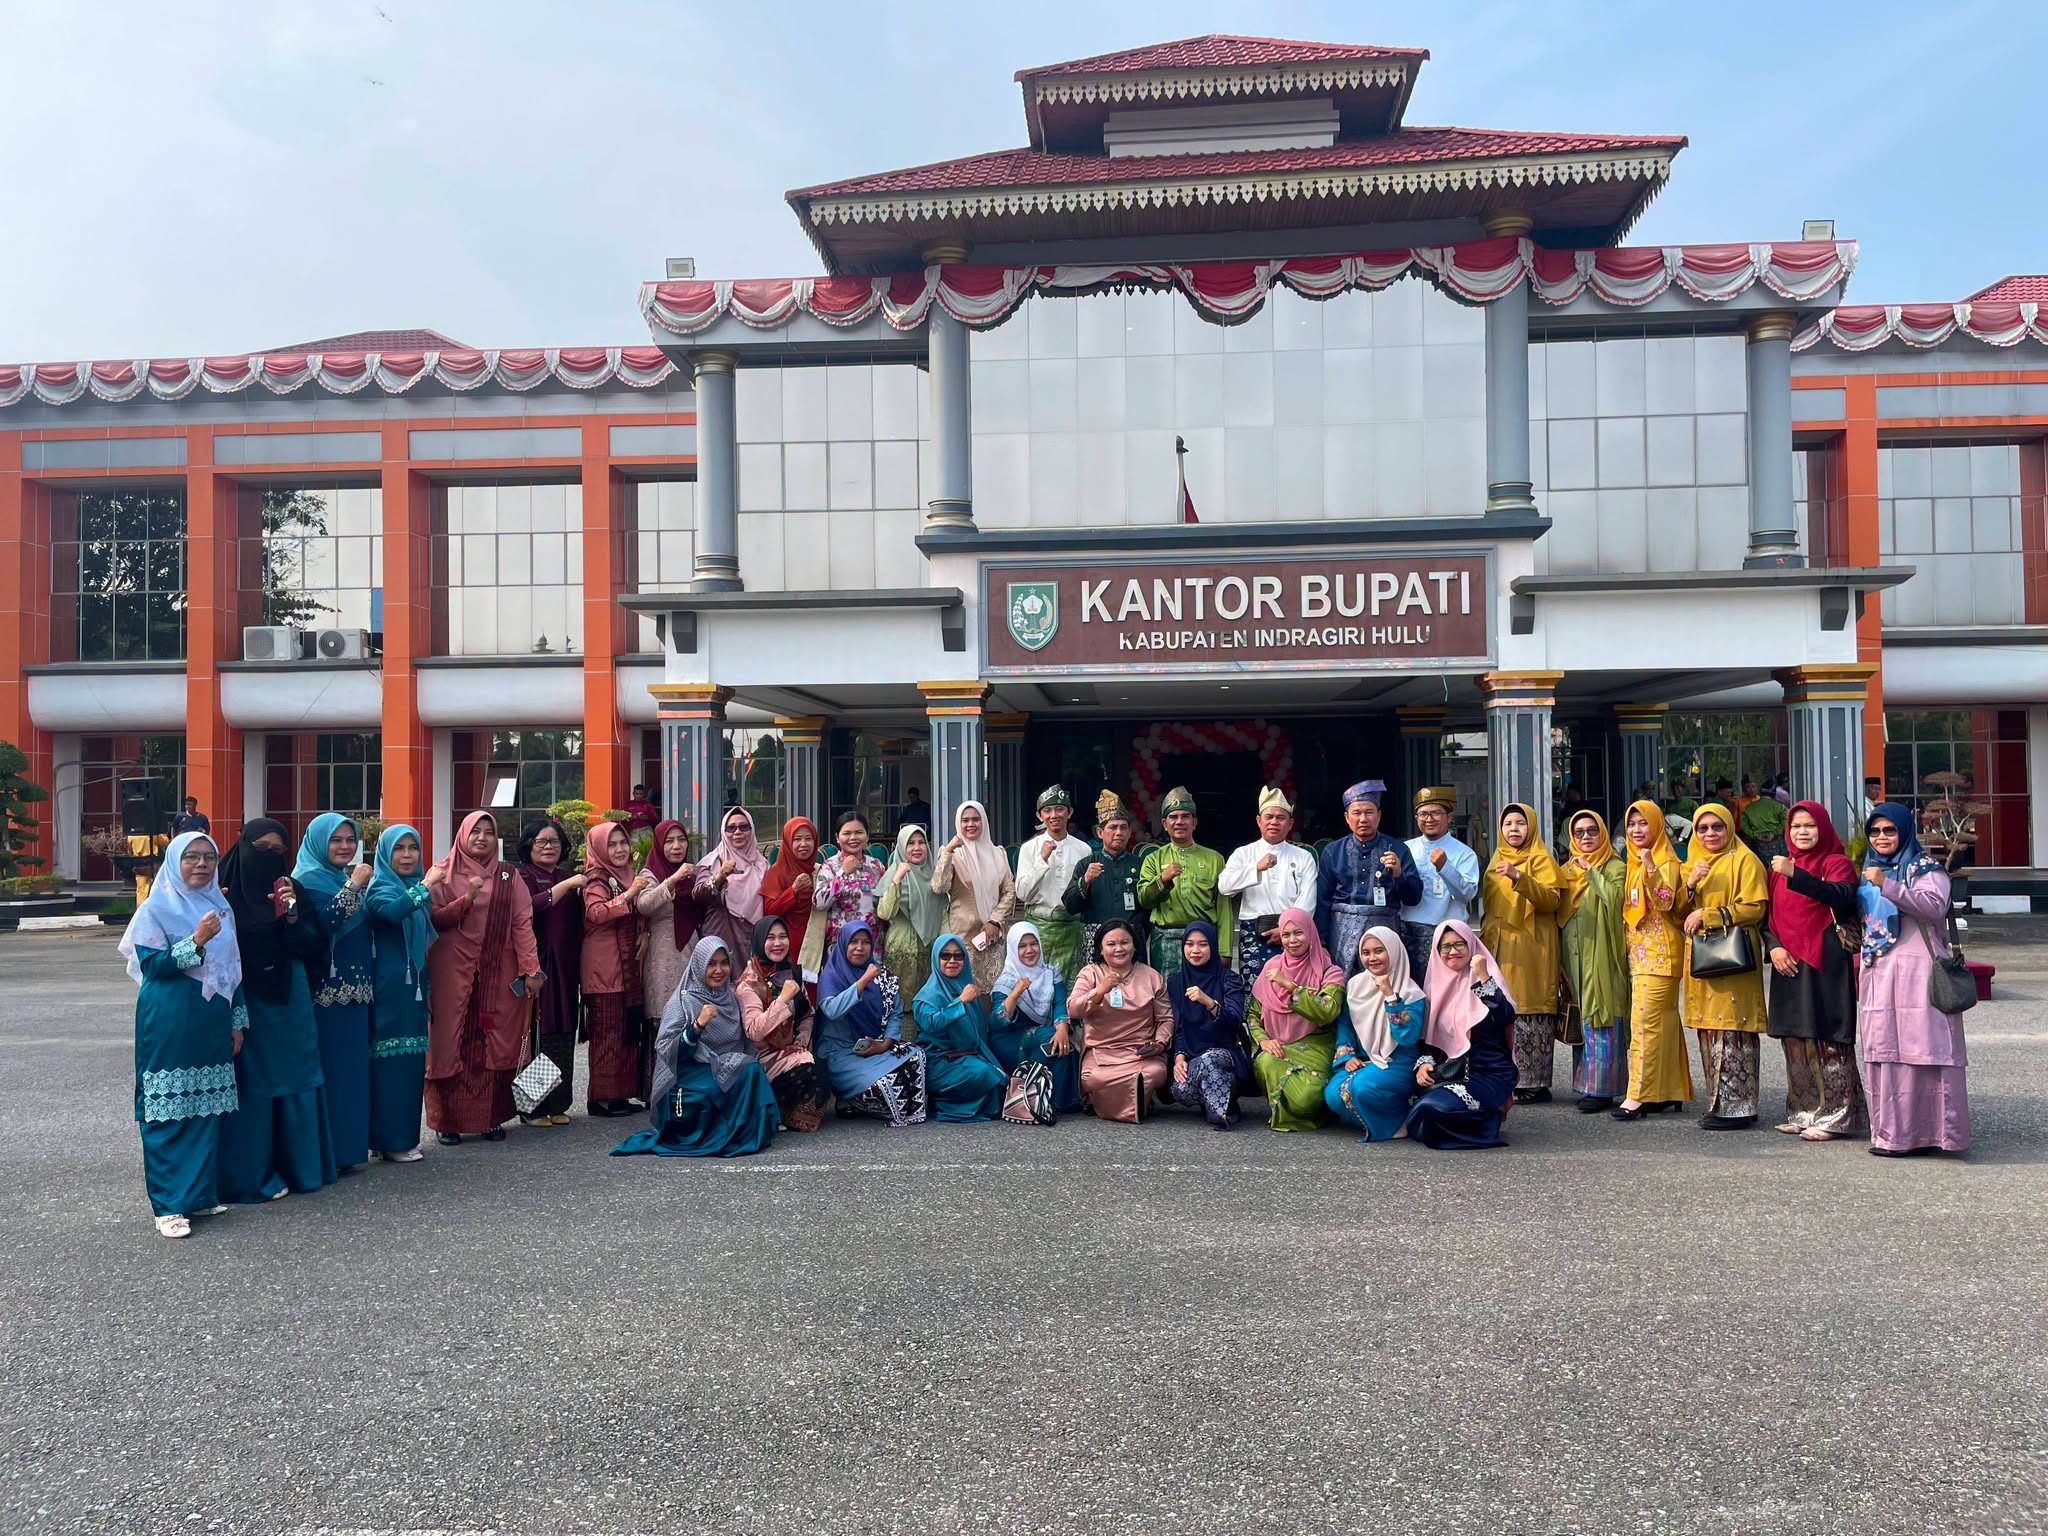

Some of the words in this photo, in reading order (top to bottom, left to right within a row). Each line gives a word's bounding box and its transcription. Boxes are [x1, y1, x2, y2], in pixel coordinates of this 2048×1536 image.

[1081, 576, 1285, 623] KANTOR
[1301, 571, 1470, 618] BUPATI
[1119, 629, 1248, 650] KABUPATEN
[1254, 627, 1365, 647] INDRAGIRI
[1372, 625, 1431, 645] HULU
